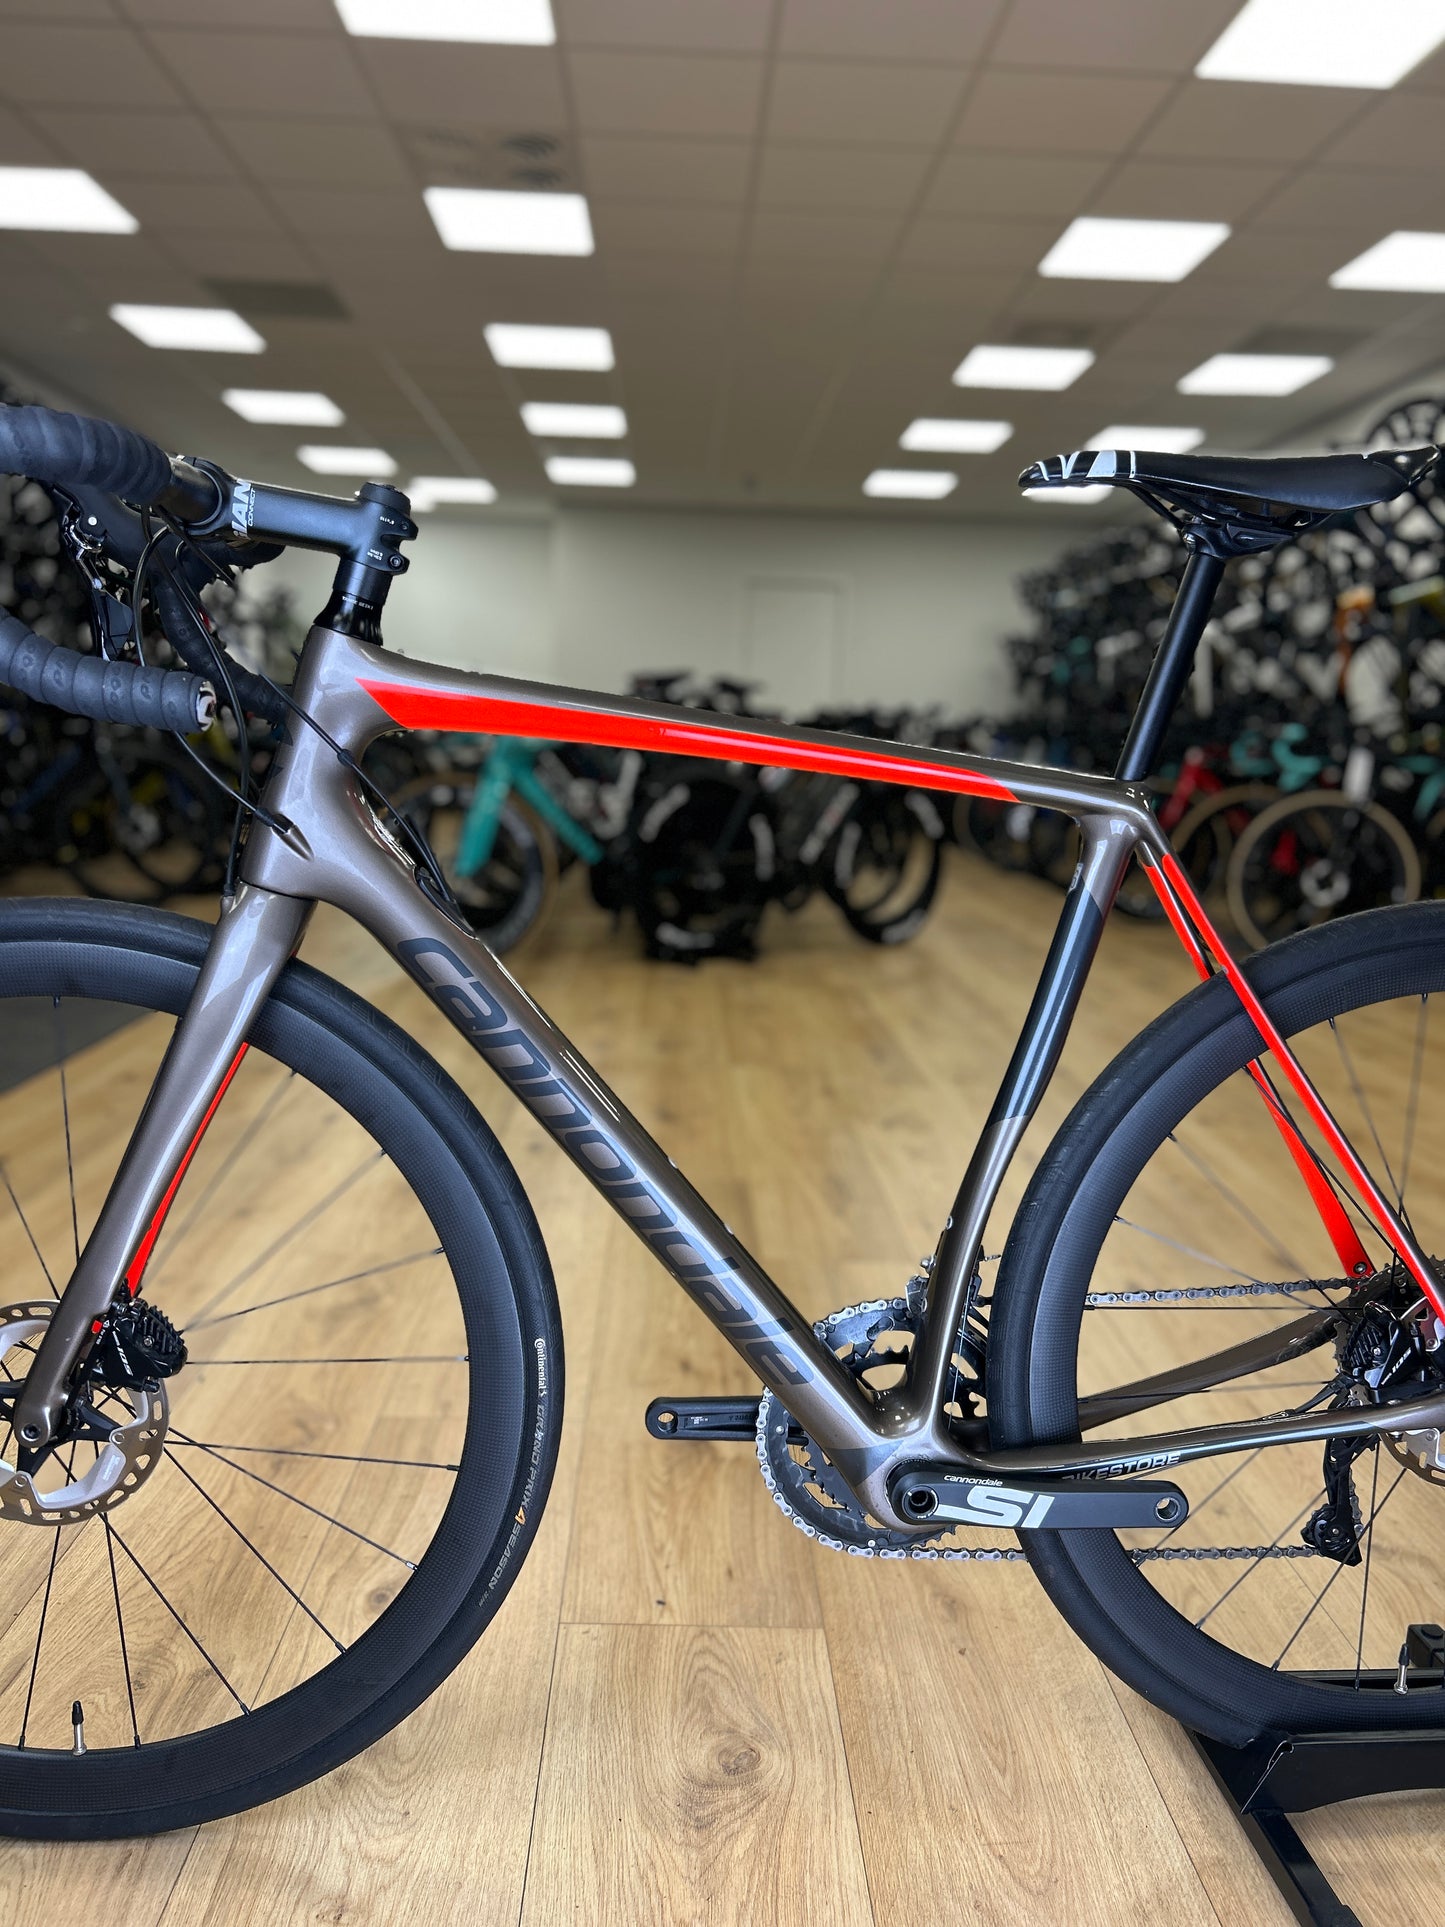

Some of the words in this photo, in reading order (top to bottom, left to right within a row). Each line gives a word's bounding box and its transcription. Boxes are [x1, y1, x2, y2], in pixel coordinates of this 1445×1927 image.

[231, 479, 251, 540] IAN
[247, 487, 256, 527] CONNECT
[397, 937, 815, 1385] cannondale
[534, 1338, 547, 1389] Continental
[531, 1404, 545, 1466] GRAND
[521, 1467, 538, 1509] PRIX
[943, 1474, 1004, 1487] cannondale
